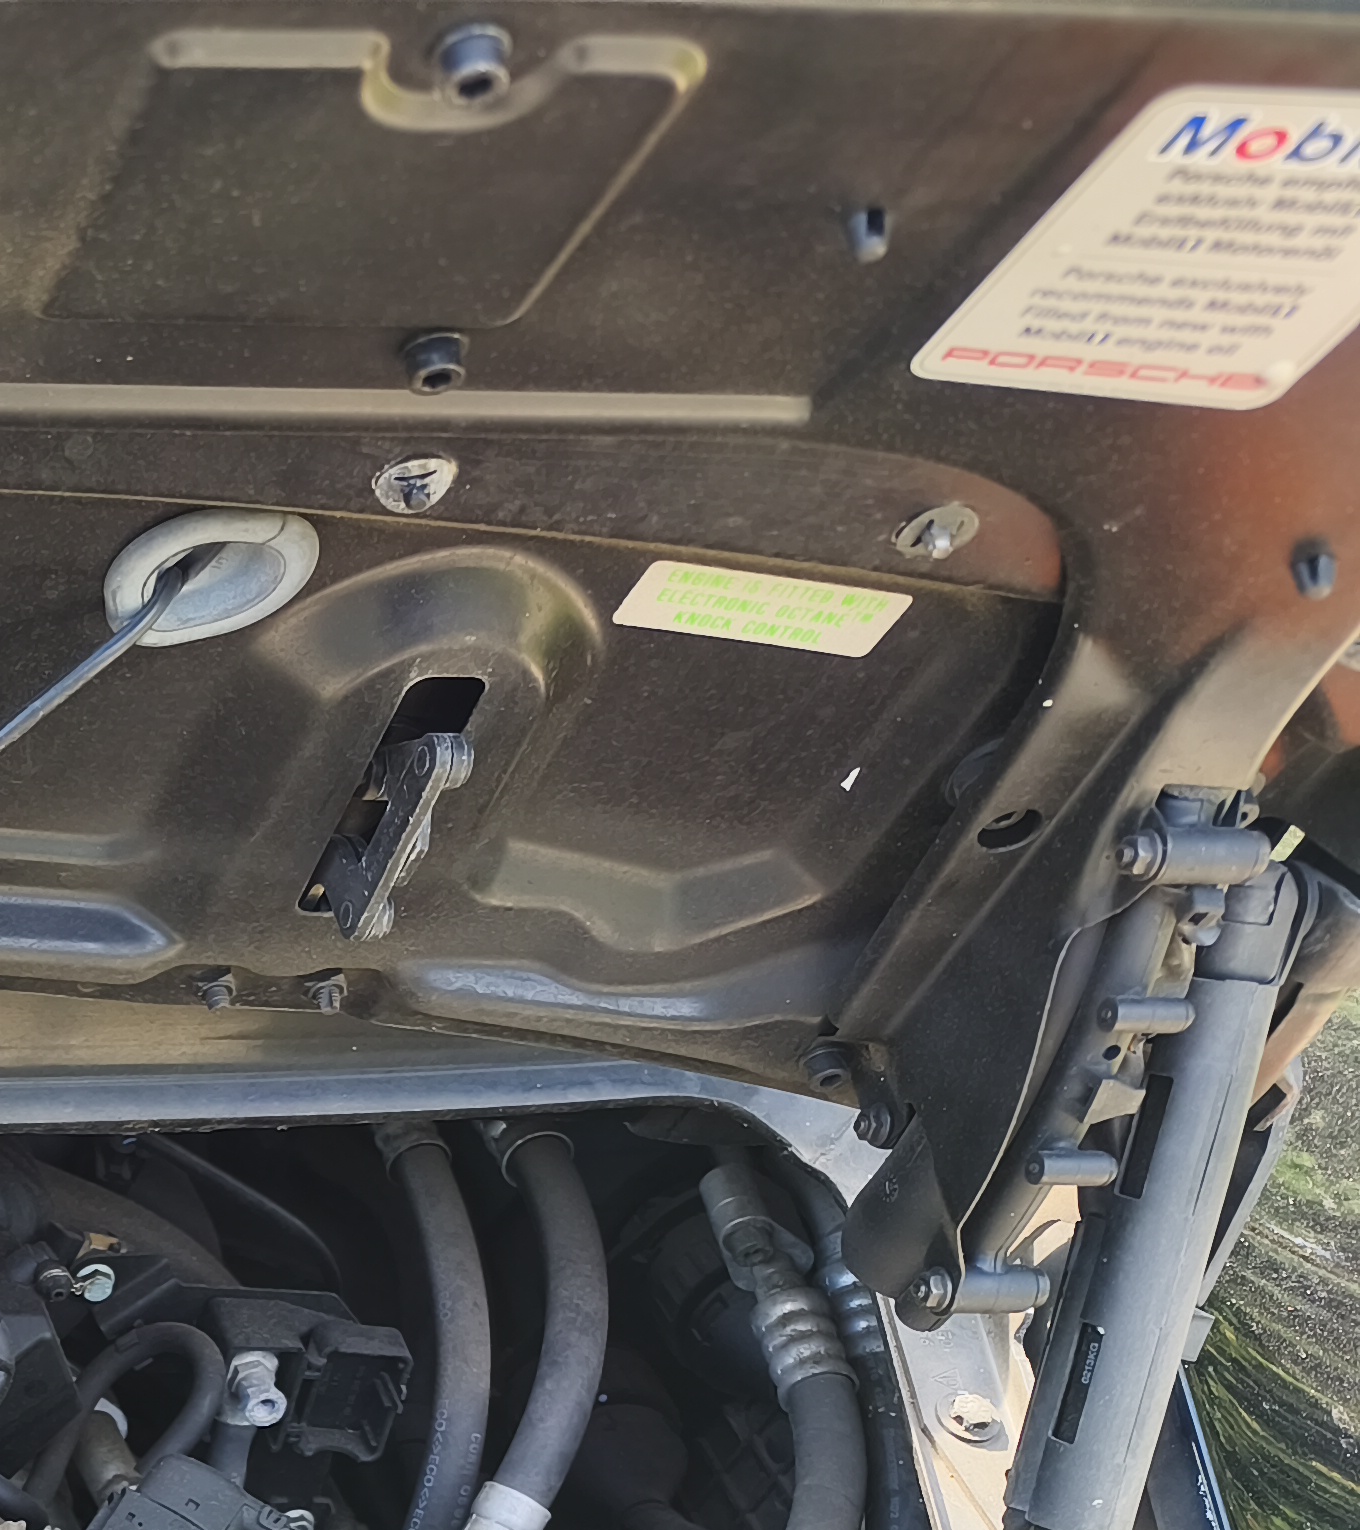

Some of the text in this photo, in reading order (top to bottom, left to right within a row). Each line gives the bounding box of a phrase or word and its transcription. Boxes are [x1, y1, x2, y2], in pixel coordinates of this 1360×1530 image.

[941, 346, 1268, 391] PORSCHE
[656, 588, 768, 617] ELECTRONIC
[667, 568, 890, 613] ENGINE IS FITTED WITH
[673, 611, 824, 645] KNOCK CONTROL
